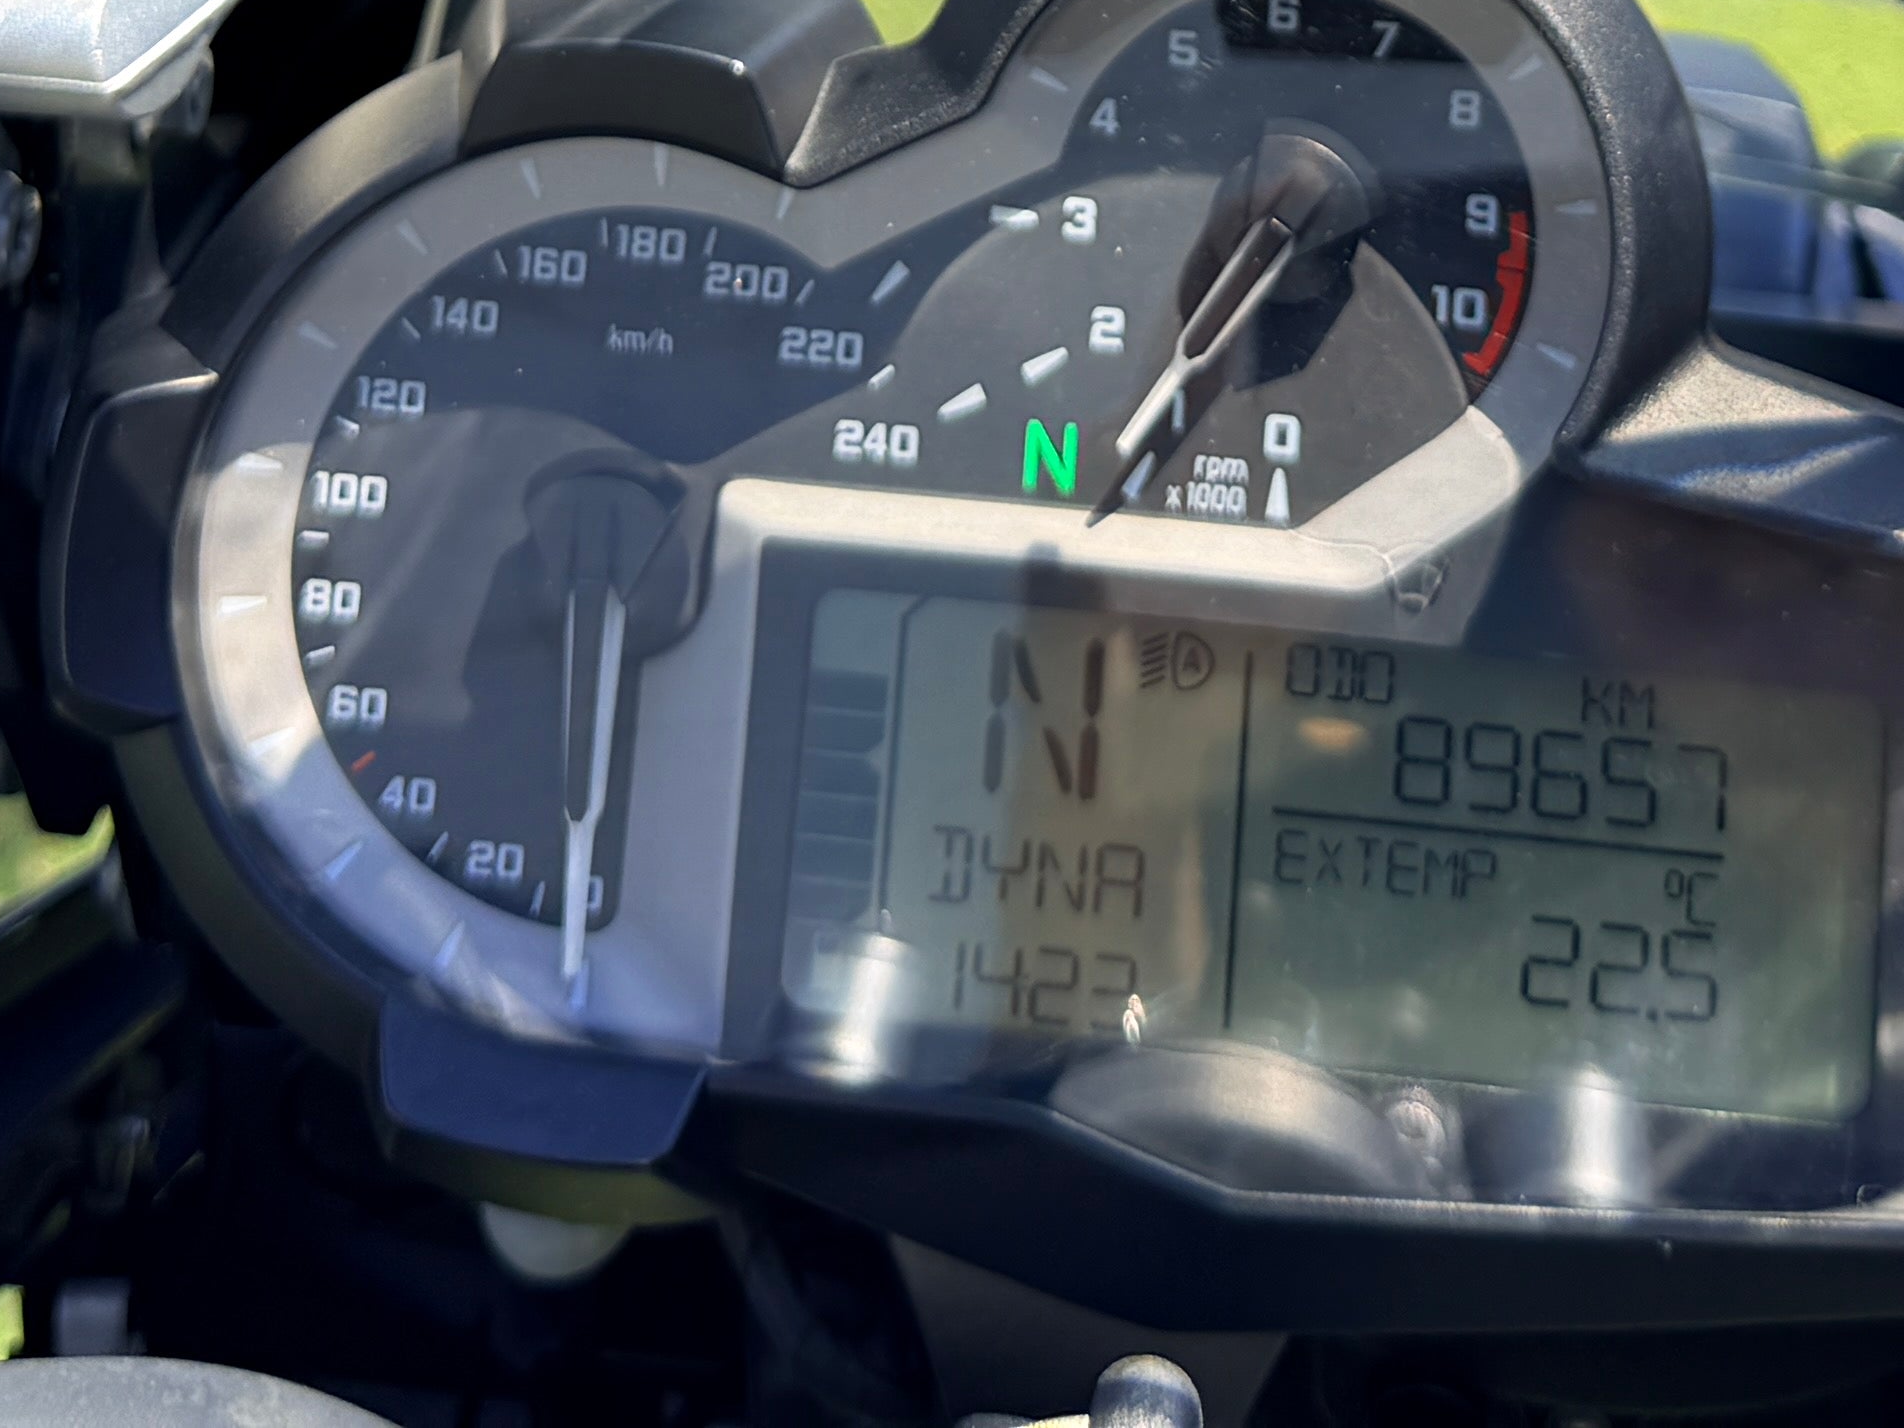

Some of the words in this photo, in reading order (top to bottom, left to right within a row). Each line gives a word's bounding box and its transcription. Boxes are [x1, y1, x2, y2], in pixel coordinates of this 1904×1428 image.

[1168, 29, 1199, 67] 5
[1373, 19, 1400, 58] 7
[1089, 97, 1120, 136] 4
[1449, 90, 1482, 129] 8
[1060, 195, 1098, 242] 3
[1464, 192, 1500, 238] 9
[518, 245, 588, 287] 160
[615, 223, 687, 264] 180
[704, 261, 790, 304] 200
[430, 295, 500, 335] 140
[1088, 304, 1127, 355] 2
[1430, 284, 1491, 331] 10
[607, 323, 674, 356] km/h
[778, 326, 864, 369] 220
[355, 375, 427, 421] 120
[832, 418, 921, 466] 240
[1022, 417, 1079, 495] N
[1263, 413, 1301, 464] 0
[1193, 453, 1249, 486] rpm
[311, 470, 389, 517] 100
[299, 577, 362, 625] 80
[1285, 642, 1395, 705] ODO
[326, 684, 388, 732] 60
[982, 627, 1106, 801] N
[1581, 675, 1656, 731] KM
[378, 775, 437, 818] 40
[1395, 714, 1729, 832] 89657
[463, 839, 525, 887] 20
[929, 823, 1146, 918] DYNA
[1273, 828, 1497, 900] EXTEMP
[953, 941, 1139, 1030] 1423
[1520, 914, 1718, 1024] 22.5
